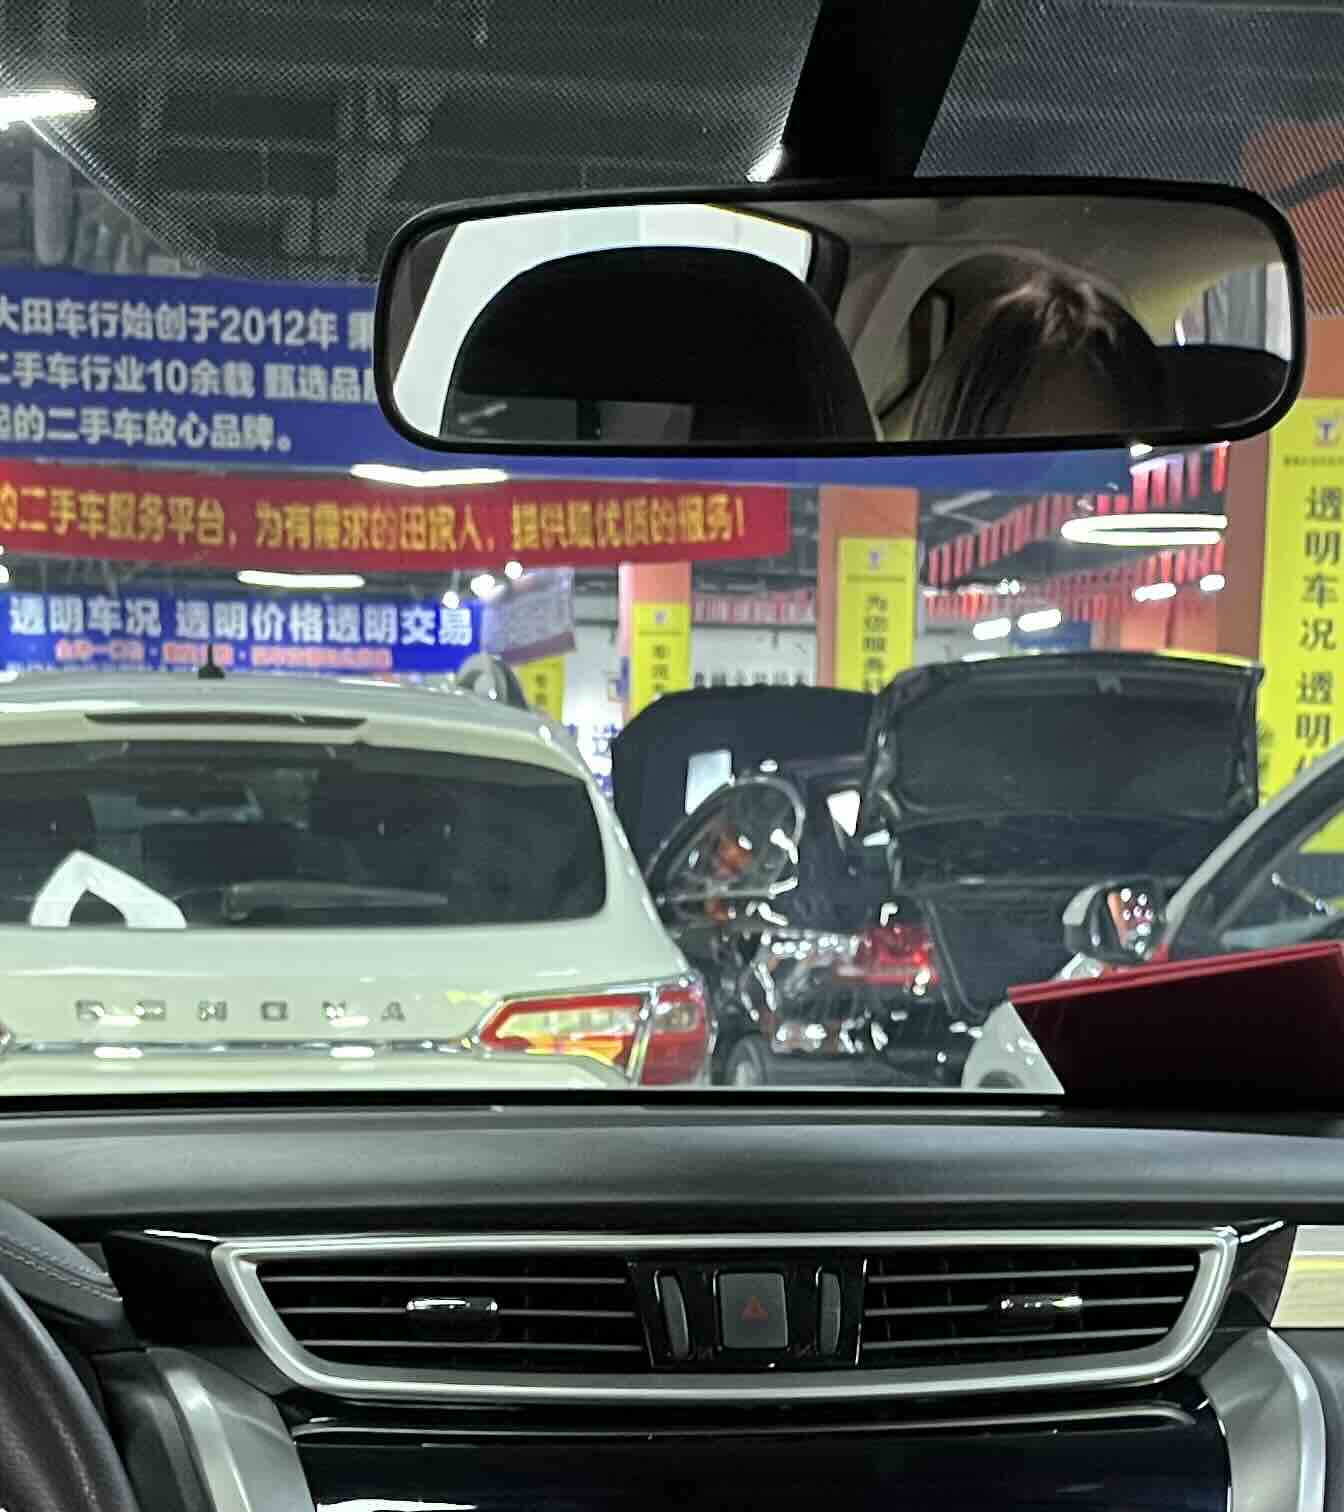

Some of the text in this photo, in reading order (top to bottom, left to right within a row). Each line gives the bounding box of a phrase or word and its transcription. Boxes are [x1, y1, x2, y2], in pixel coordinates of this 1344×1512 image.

[9, 595, 473, 647] 透明车况 透明价格透明交易
[1296, 484, 1344, 652] 透明车况
